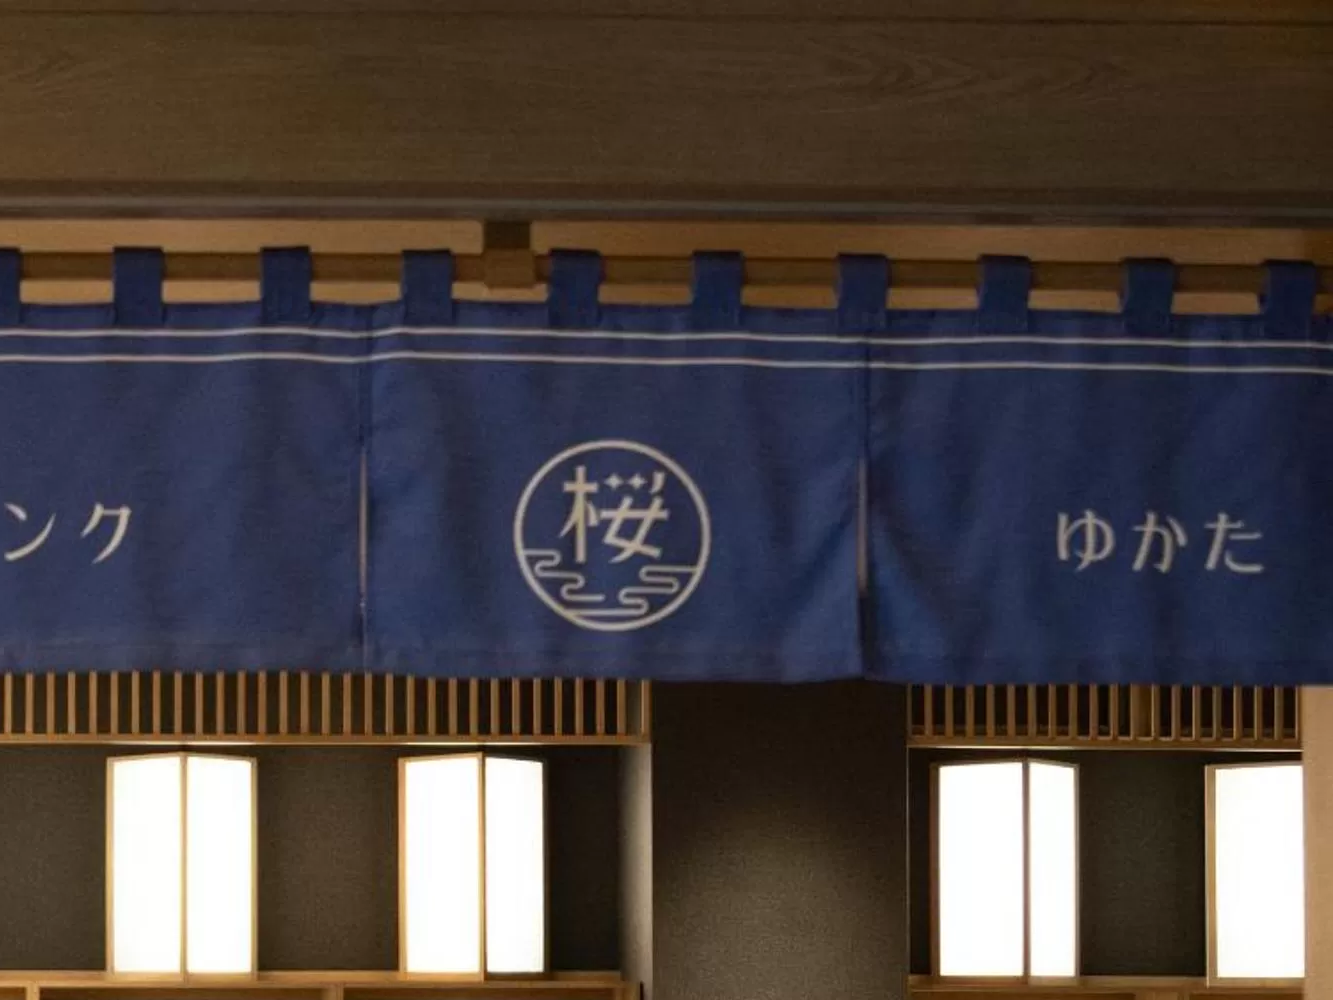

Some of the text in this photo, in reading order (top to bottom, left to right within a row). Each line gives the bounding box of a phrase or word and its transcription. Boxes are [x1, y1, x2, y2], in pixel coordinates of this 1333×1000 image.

[559, 464, 669, 565] 桜
[1056, 509, 1264, 574] ゆかた
